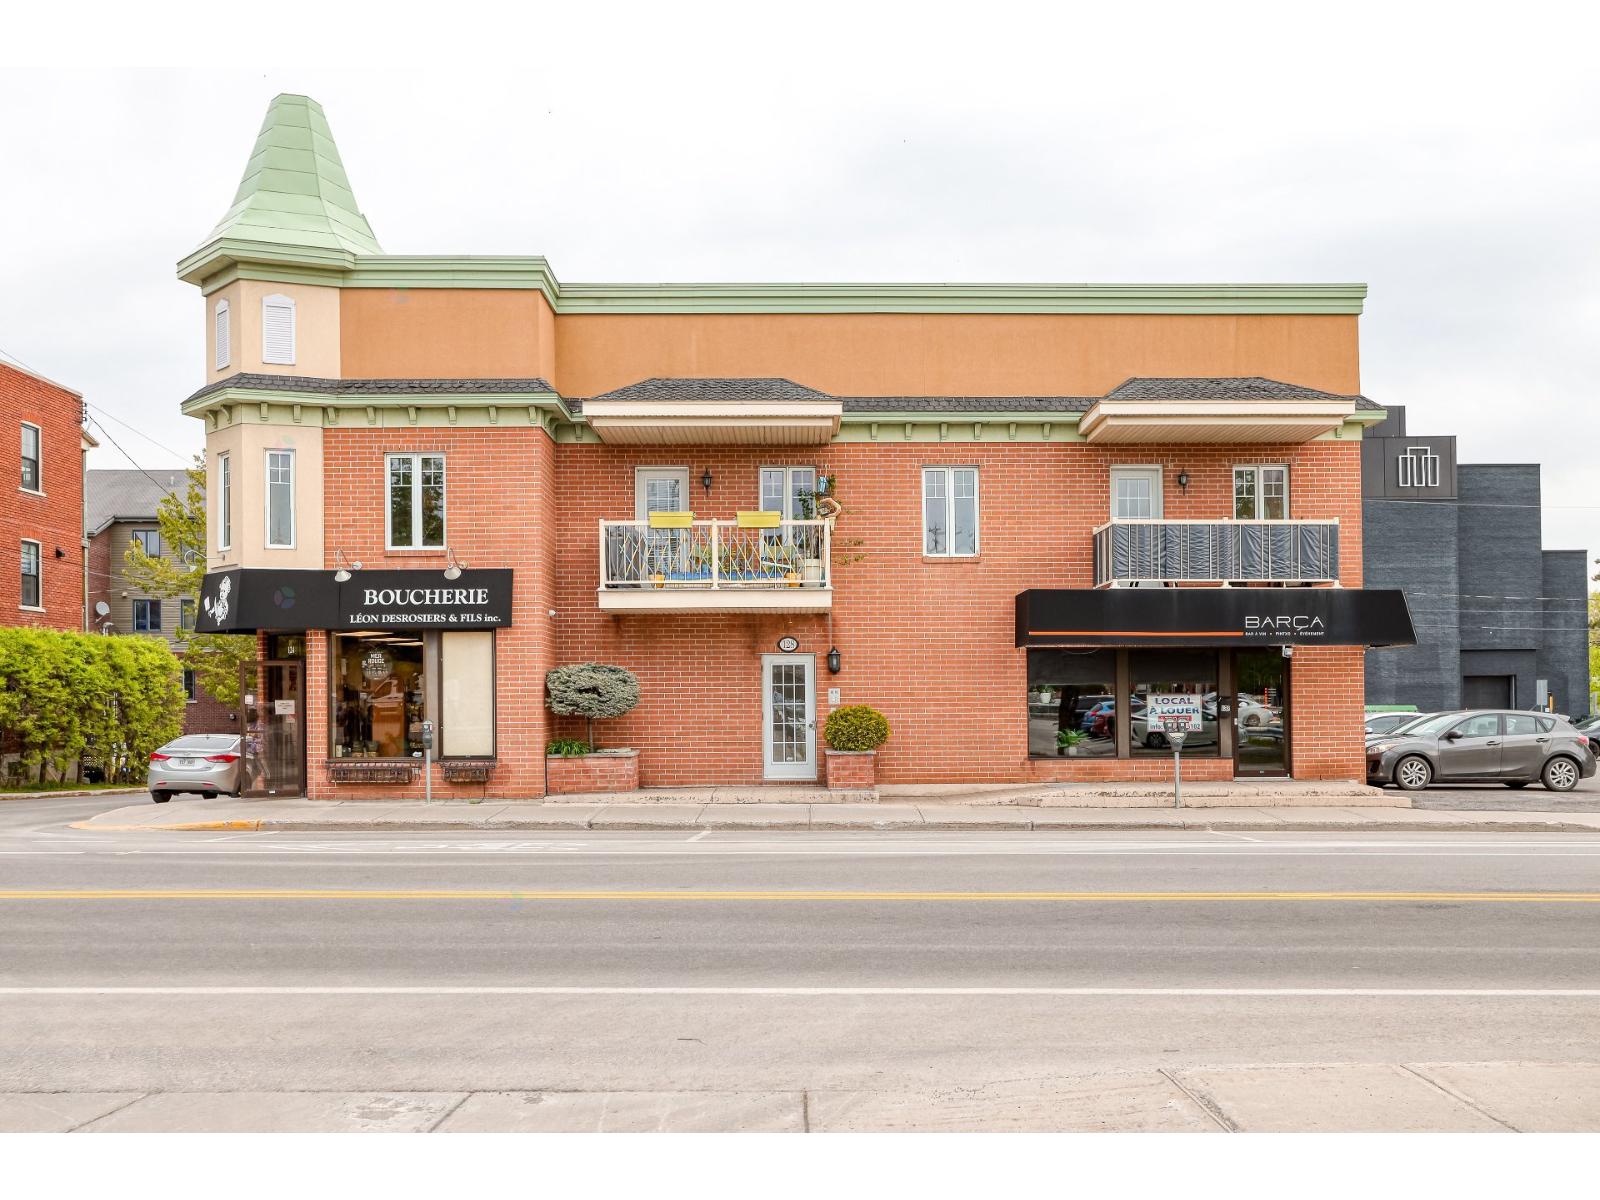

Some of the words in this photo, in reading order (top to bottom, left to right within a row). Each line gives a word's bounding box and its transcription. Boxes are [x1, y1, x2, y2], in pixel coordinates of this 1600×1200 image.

[363, 589, 489, 605] BOUCHERIE
[349, 612, 379, 623] LÉON
[382, 614, 446, 623] DESROSIERS
[449, 613, 458, 622] &
[460, 613, 482, 622] FILS
[484, 613, 501, 622] inc.
[1245, 616, 1324, 630] BARÇA
[783, 640, 795, 648] 128
[1155, 697, 1194, 705] LOCAL
[1160, 706, 1200, 714] LOUER
